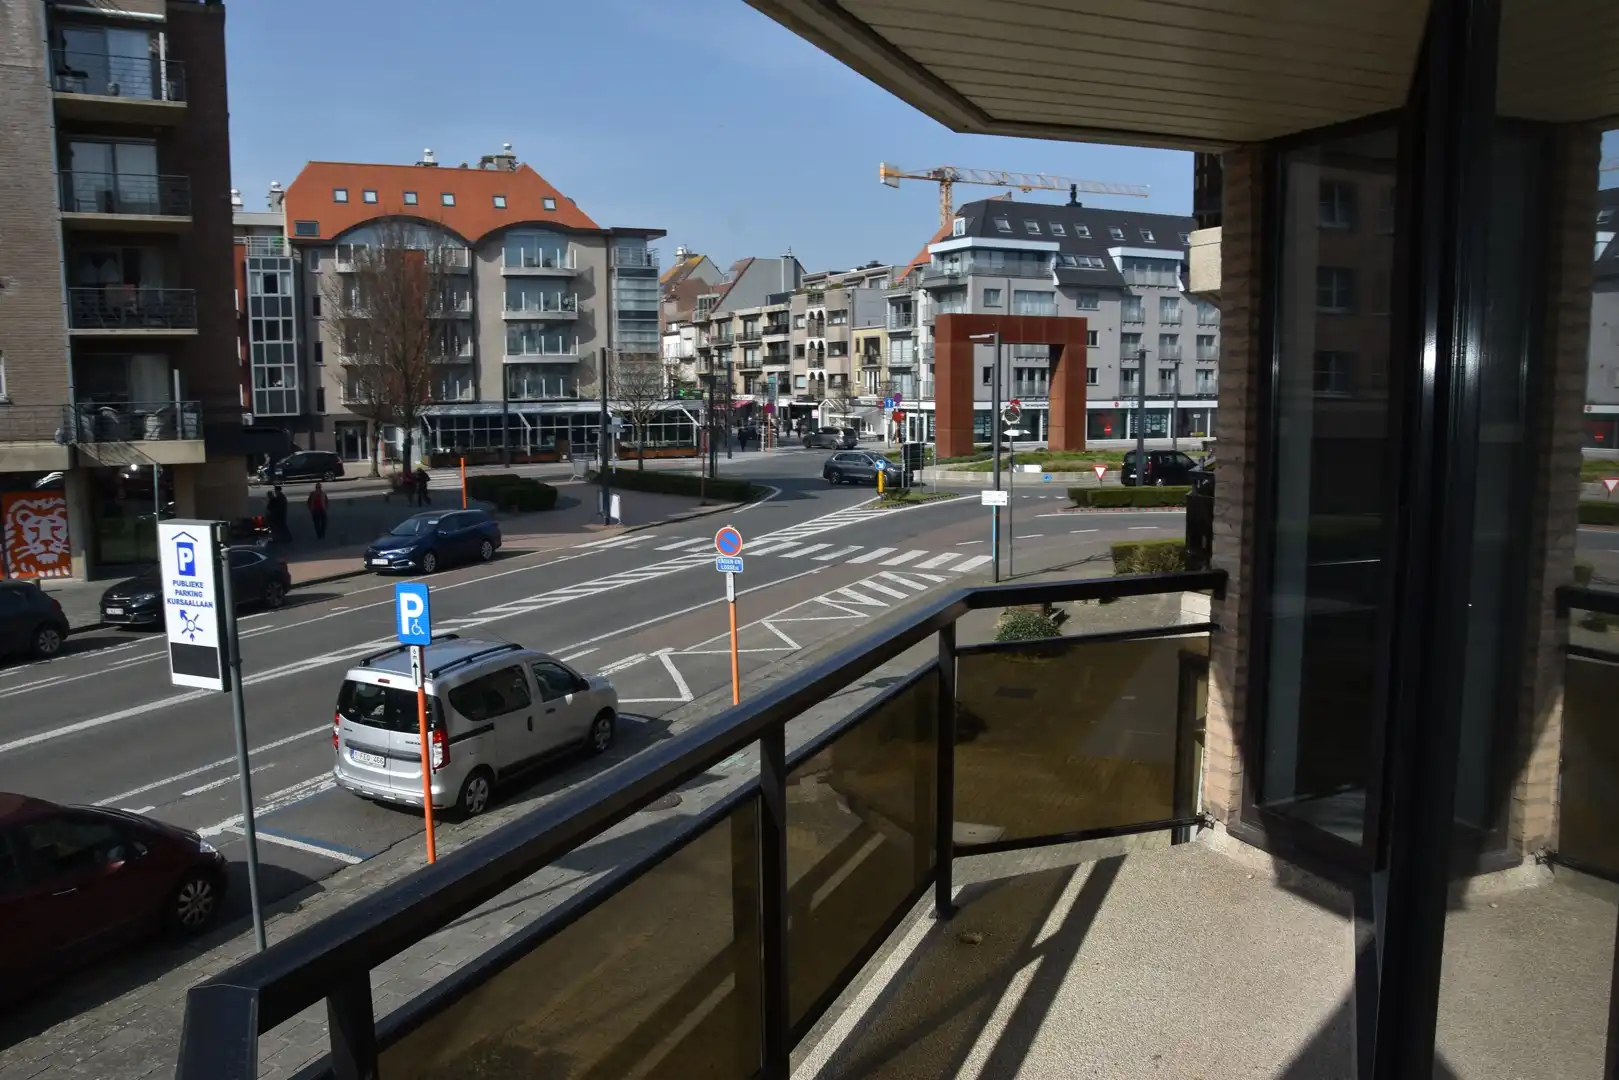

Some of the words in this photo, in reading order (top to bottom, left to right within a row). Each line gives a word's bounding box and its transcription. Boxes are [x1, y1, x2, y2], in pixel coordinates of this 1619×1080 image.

[178, 547, 194, 572] P
[172, 579, 204, 589] PUBLIEKE
[175, 589, 203, 598] PARKING
[167, 598, 213, 608] KURSAALLAAN
[400, 592, 424, 635] P
